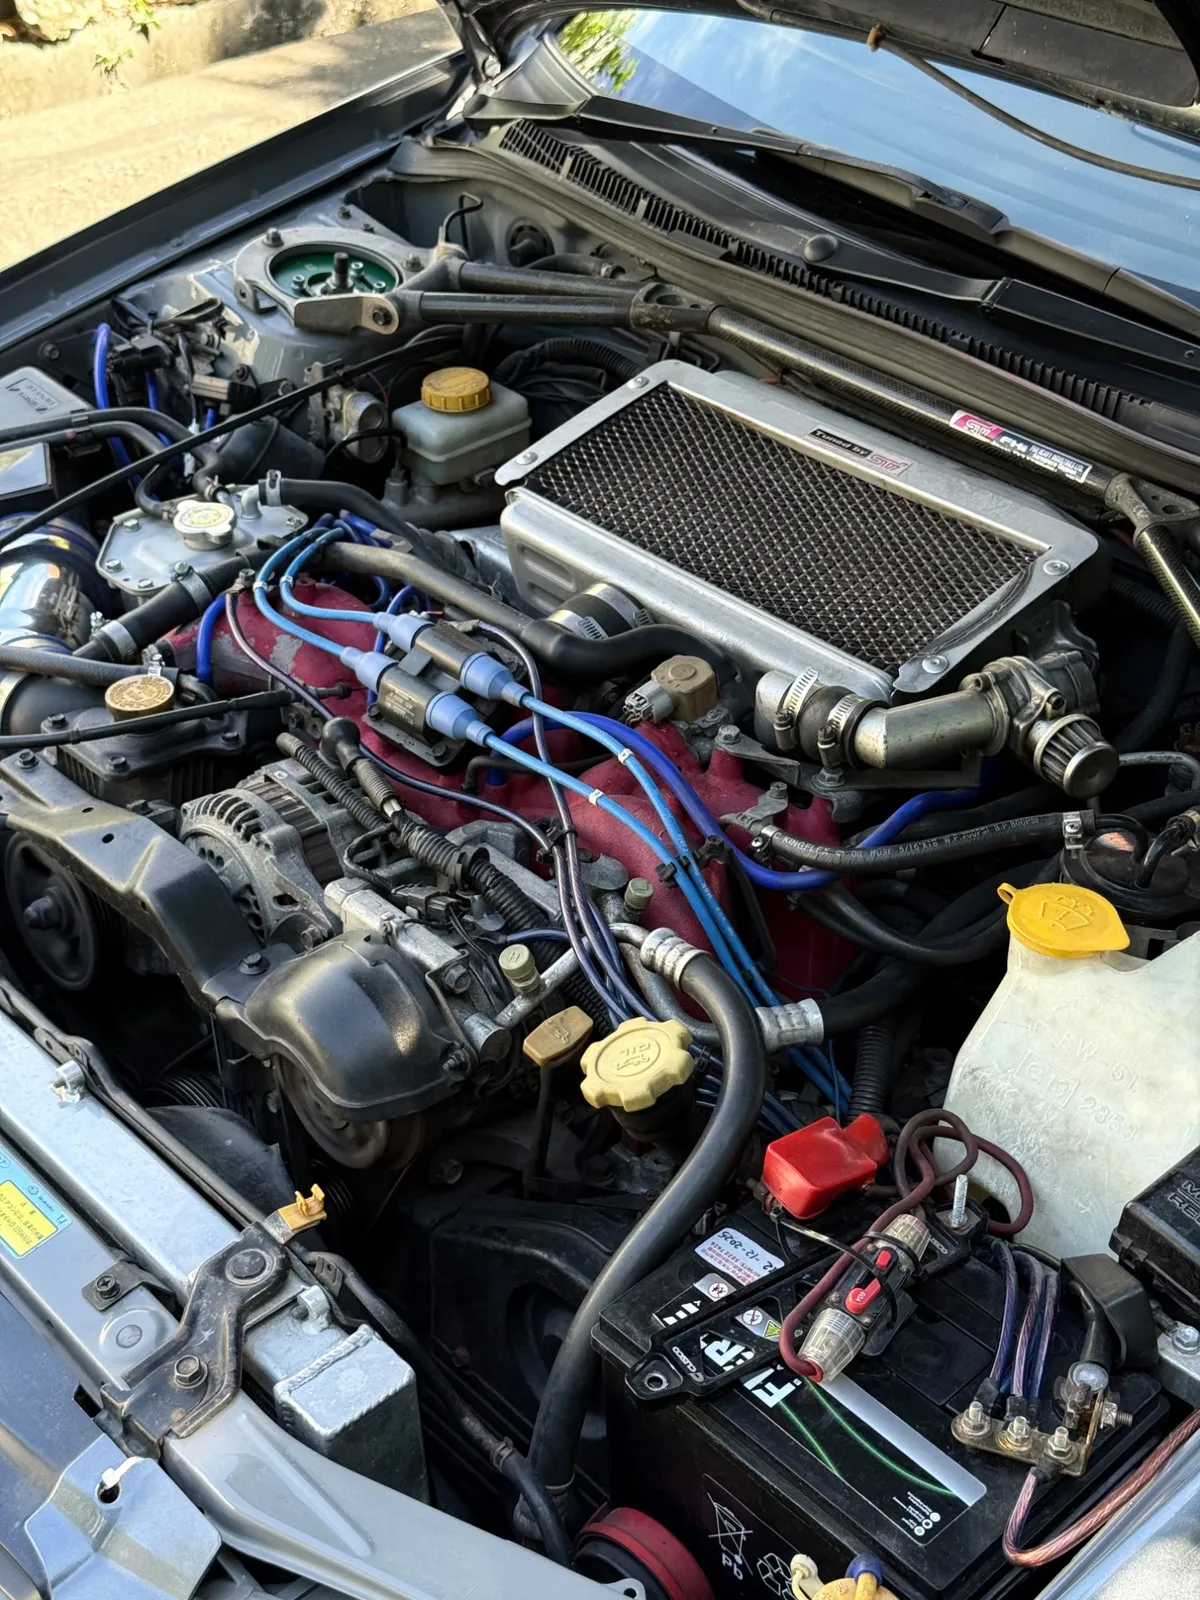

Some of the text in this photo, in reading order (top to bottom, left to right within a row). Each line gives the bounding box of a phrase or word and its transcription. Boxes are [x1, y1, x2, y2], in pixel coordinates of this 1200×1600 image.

[815, 430, 852, 449] Tuned
[852, 447, 868, 456] by
[783, 836, 831, 856] KINGFLEX
[671, 1345, 698, 1374] CUSCO
[721, 1552, 744, 1580] Pb
